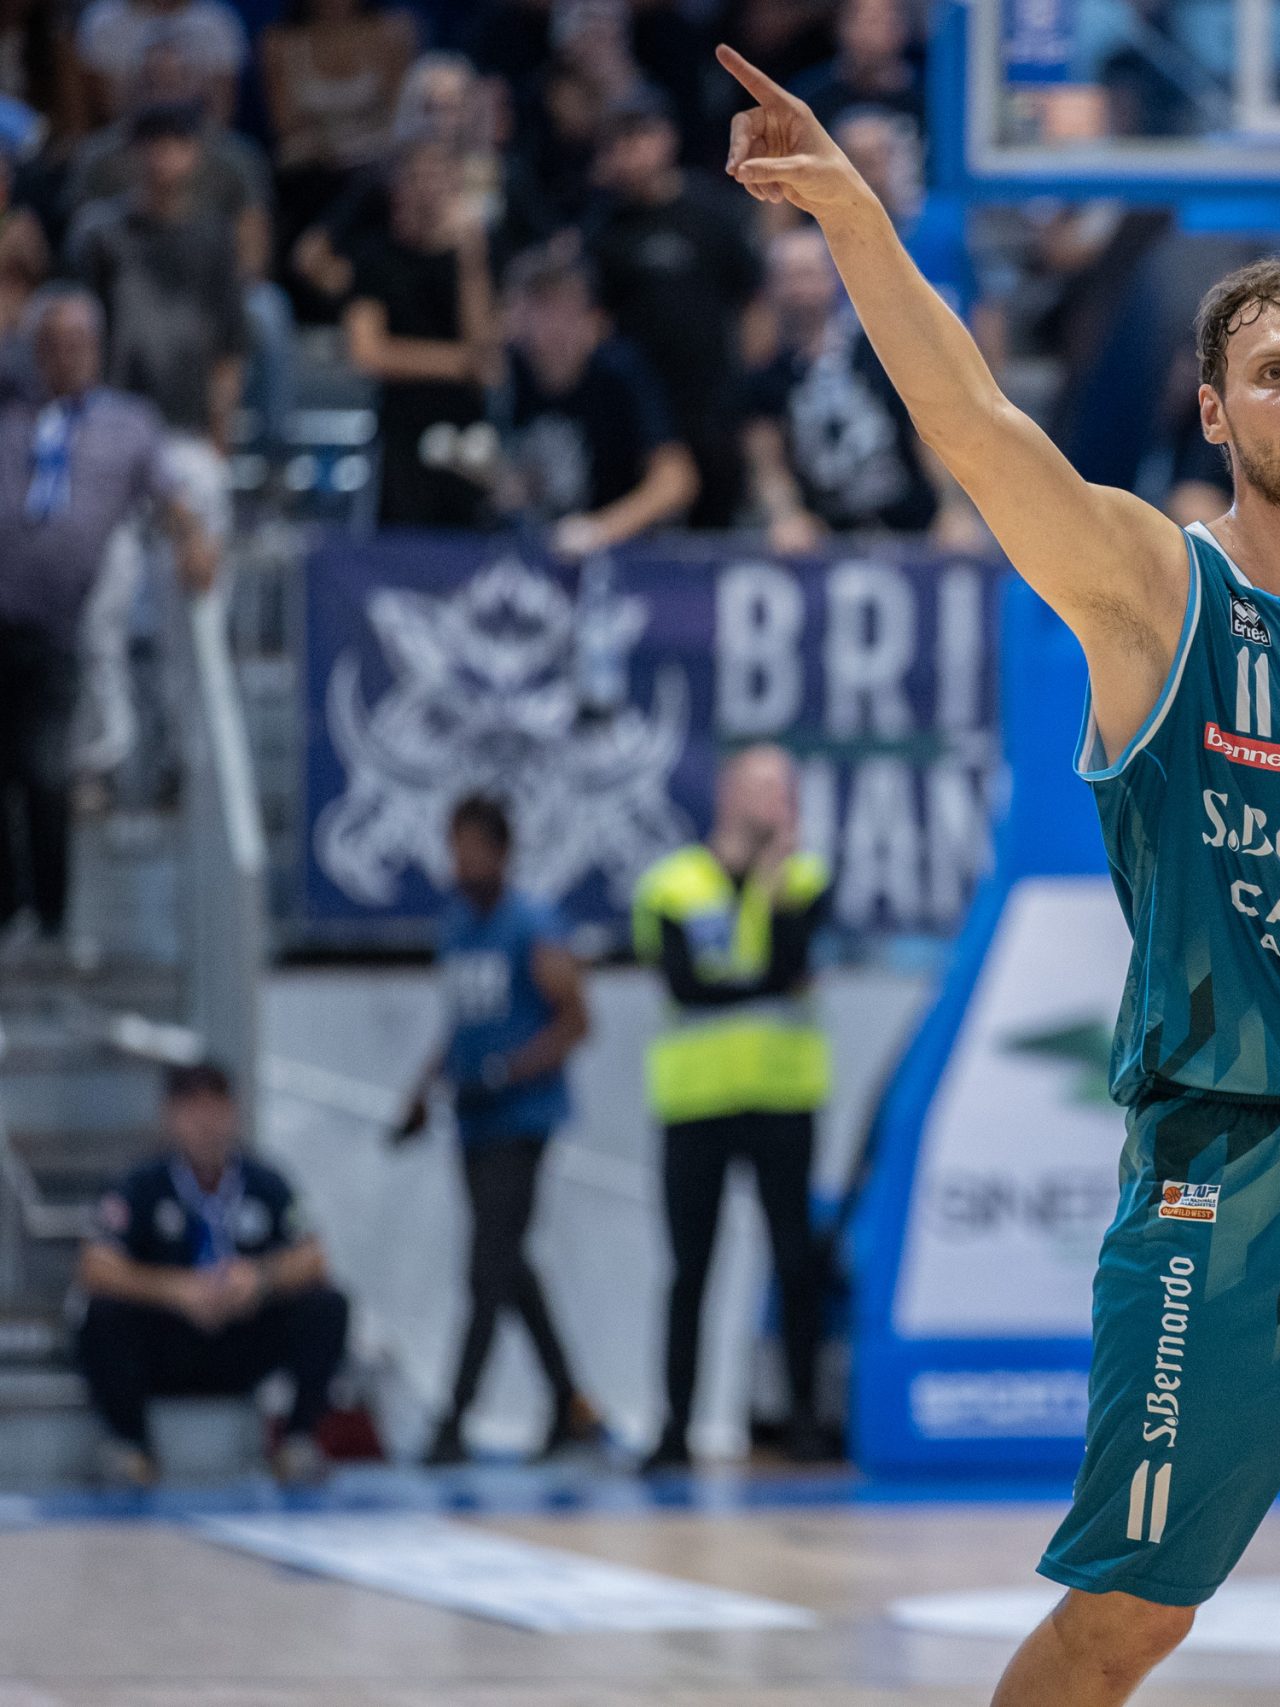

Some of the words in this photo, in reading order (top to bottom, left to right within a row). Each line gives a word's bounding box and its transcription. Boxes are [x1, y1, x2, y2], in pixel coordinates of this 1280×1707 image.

[1236, 646, 1272, 738] 11
[1143, 1255, 1196, 1448] S.Bernardo
[1126, 1458, 1173, 1544] 11
